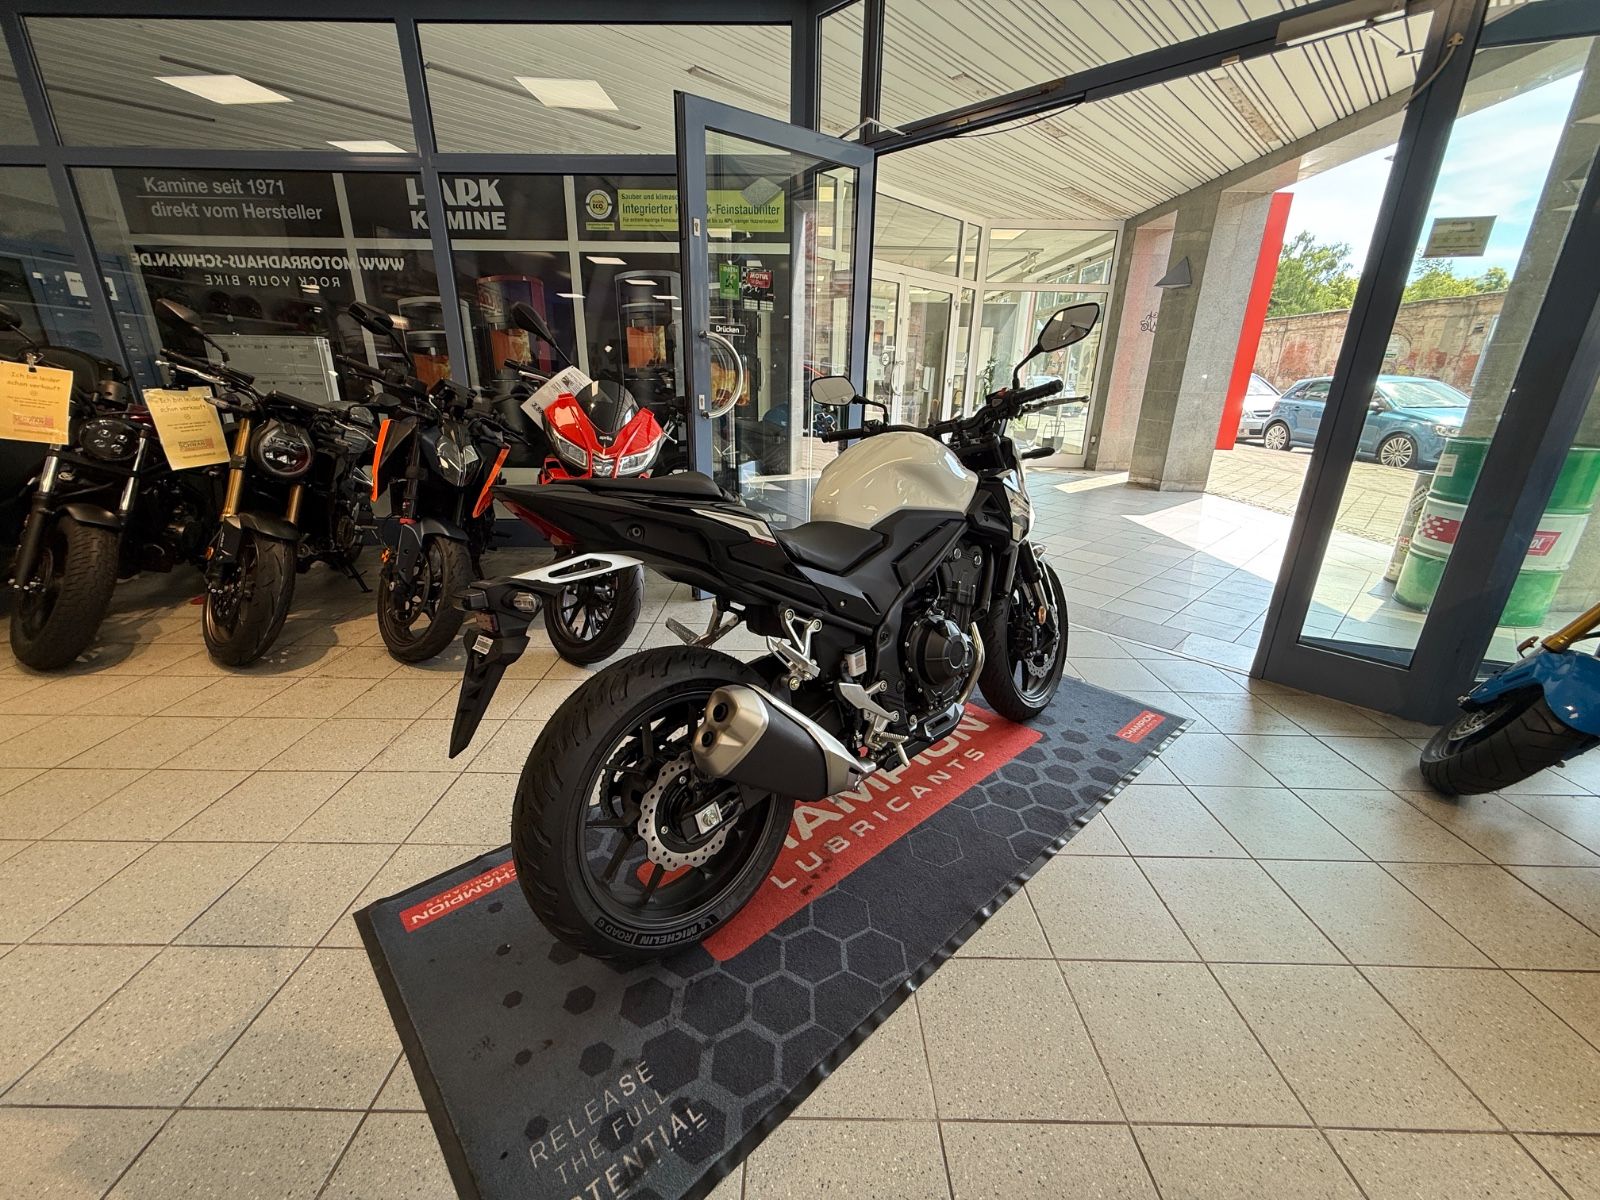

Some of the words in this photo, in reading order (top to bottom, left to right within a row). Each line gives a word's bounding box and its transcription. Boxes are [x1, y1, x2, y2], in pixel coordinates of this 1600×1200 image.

[143, 177, 208, 194] Kamine
[213, 178, 244, 194] seit
[247, 179, 285, 195] 1971
[151, 202, 200, 218] direkt
[202, 207, 239, 218] vom
[242, 203, 322, 220] Hersteller
[622, 203, 672, 216] Integrierter
[410, 211, 507, 230] KMINE
[715, 325, 740, 333] Drücken
[769, 747, 986, 890] LUBRICANTS
[605, 925, 634, 941] ROAD
[640, 924, 698, 945] MICHELIN
[529, 1060, 654, 1169] RELEASE
[554, 1135, 606, 1185] THE
[611, 1089, 670, 1141] FULL
